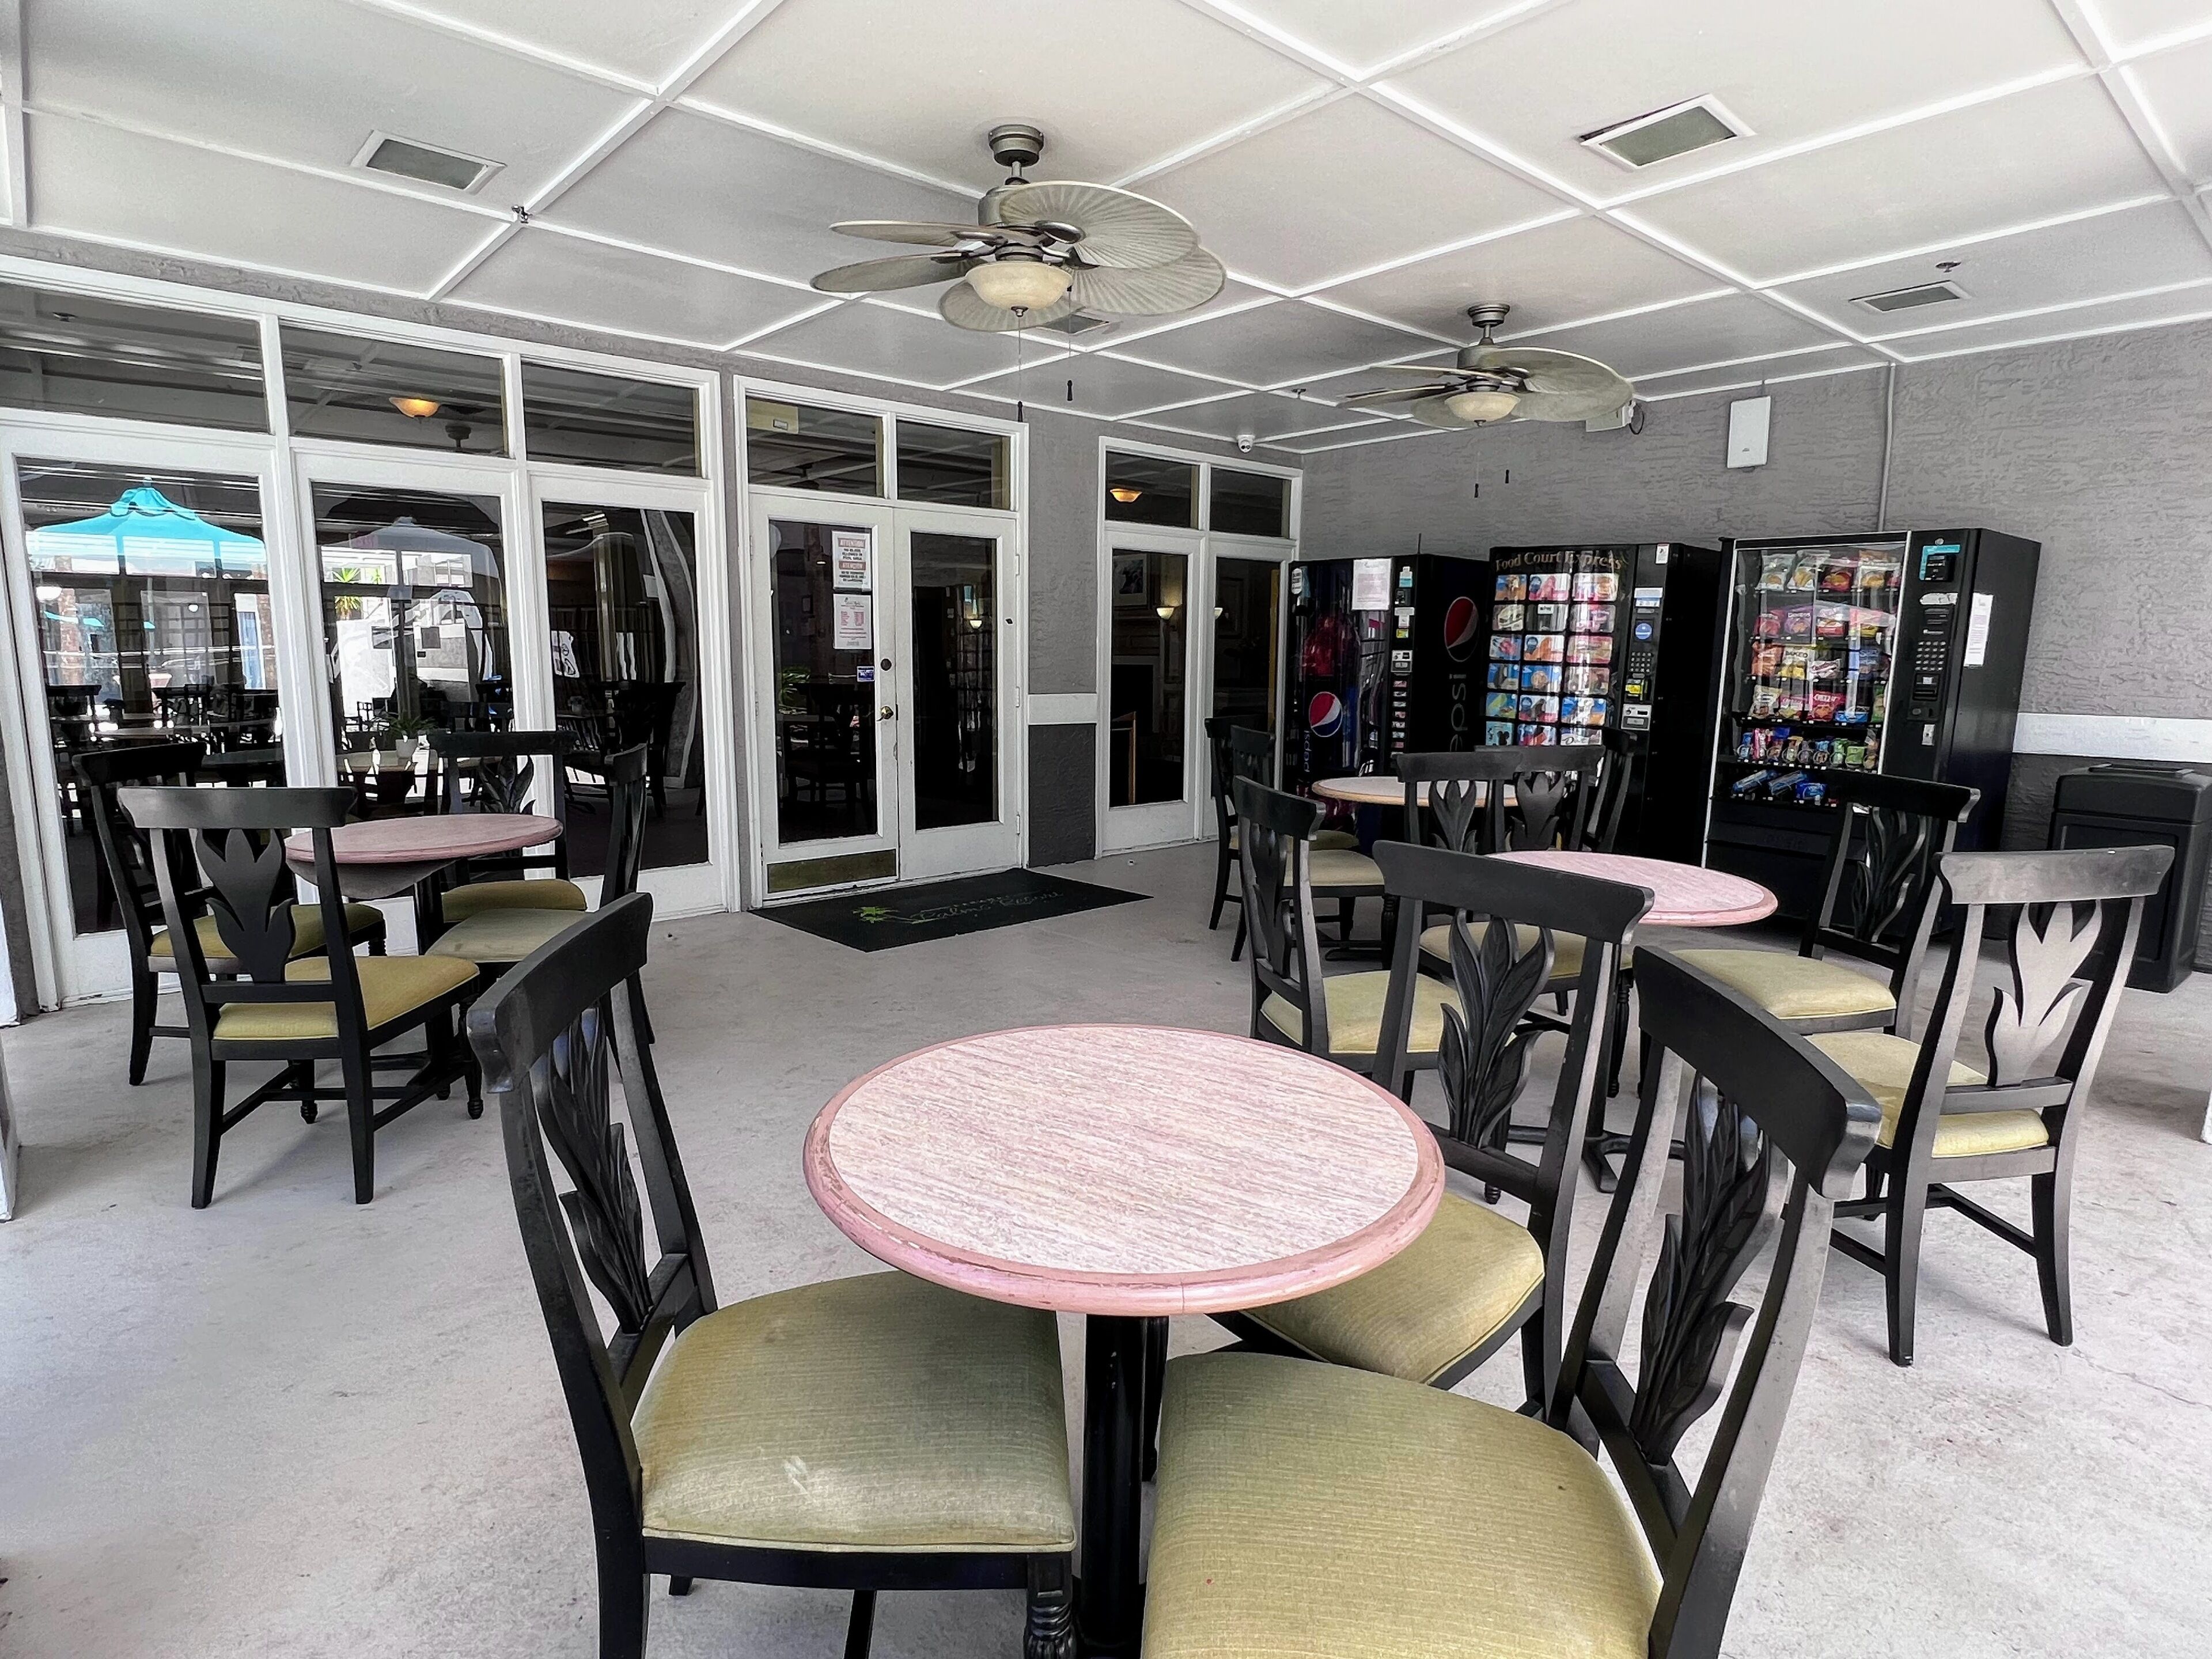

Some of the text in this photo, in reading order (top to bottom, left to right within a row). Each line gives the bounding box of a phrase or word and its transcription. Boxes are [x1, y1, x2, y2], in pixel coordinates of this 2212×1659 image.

[839, 539, 865, 547] ATTENTION
[1495, 550, 1623, 572] Food Court Express
[1449, 673, 1469, 752] epsi
[1304, 730, 1312, 772] pepsi
